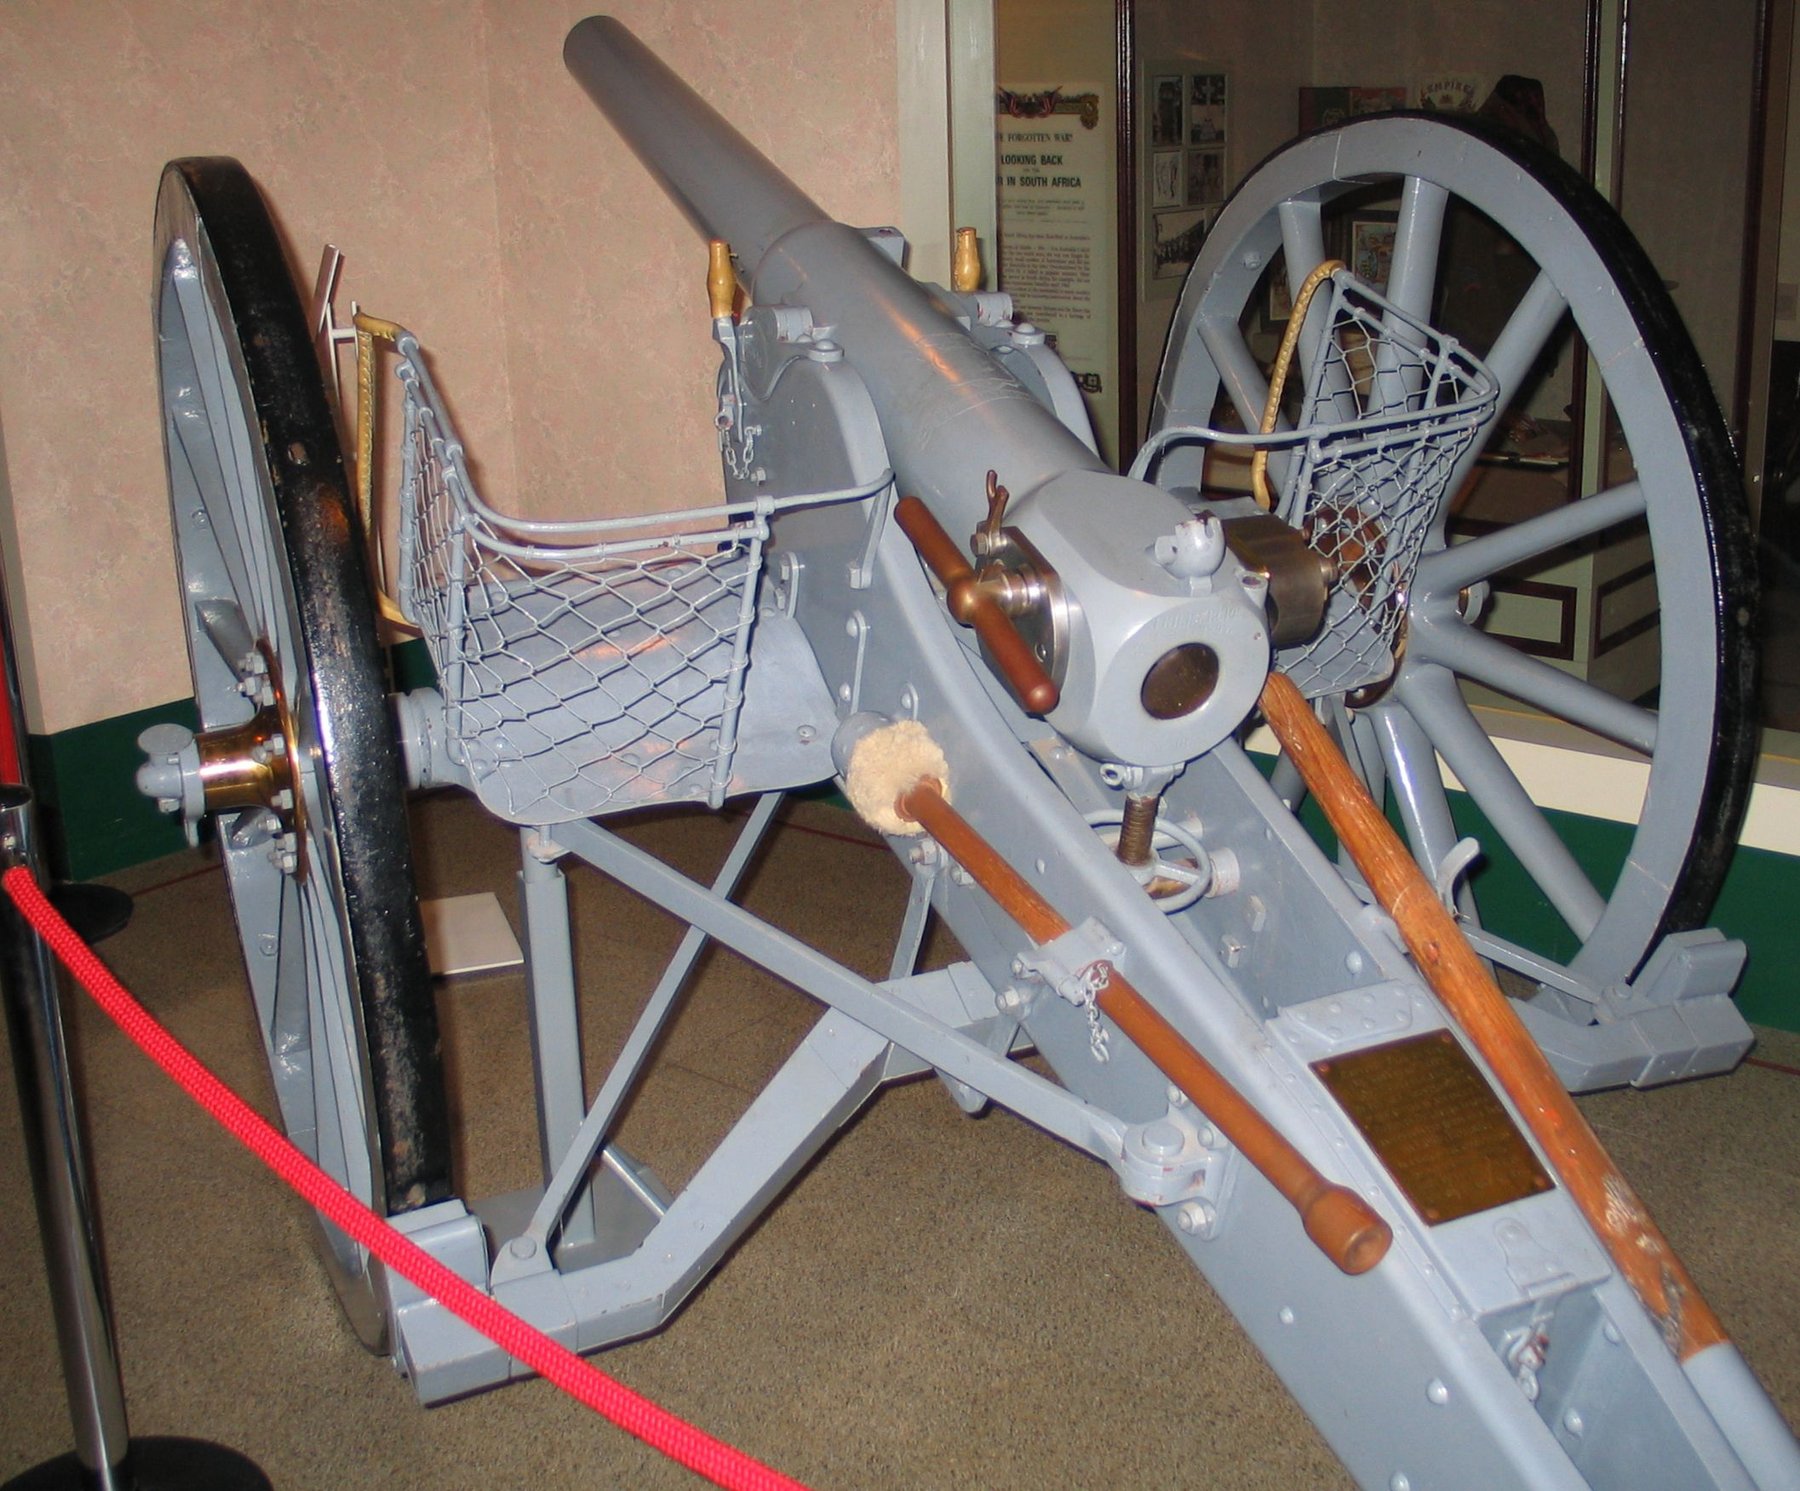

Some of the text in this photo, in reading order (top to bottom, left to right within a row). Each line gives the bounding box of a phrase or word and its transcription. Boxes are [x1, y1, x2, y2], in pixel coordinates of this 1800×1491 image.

[1008, 133, 1051, 143] FORGOTTEN
[1001, 155, 1063, 165] LOOKING BACK
[1007, 176, 1016, 186] IN
[1020, 176, 1048, 187] SOUTH
[1052, 177, 1082, 188] AFRICA
